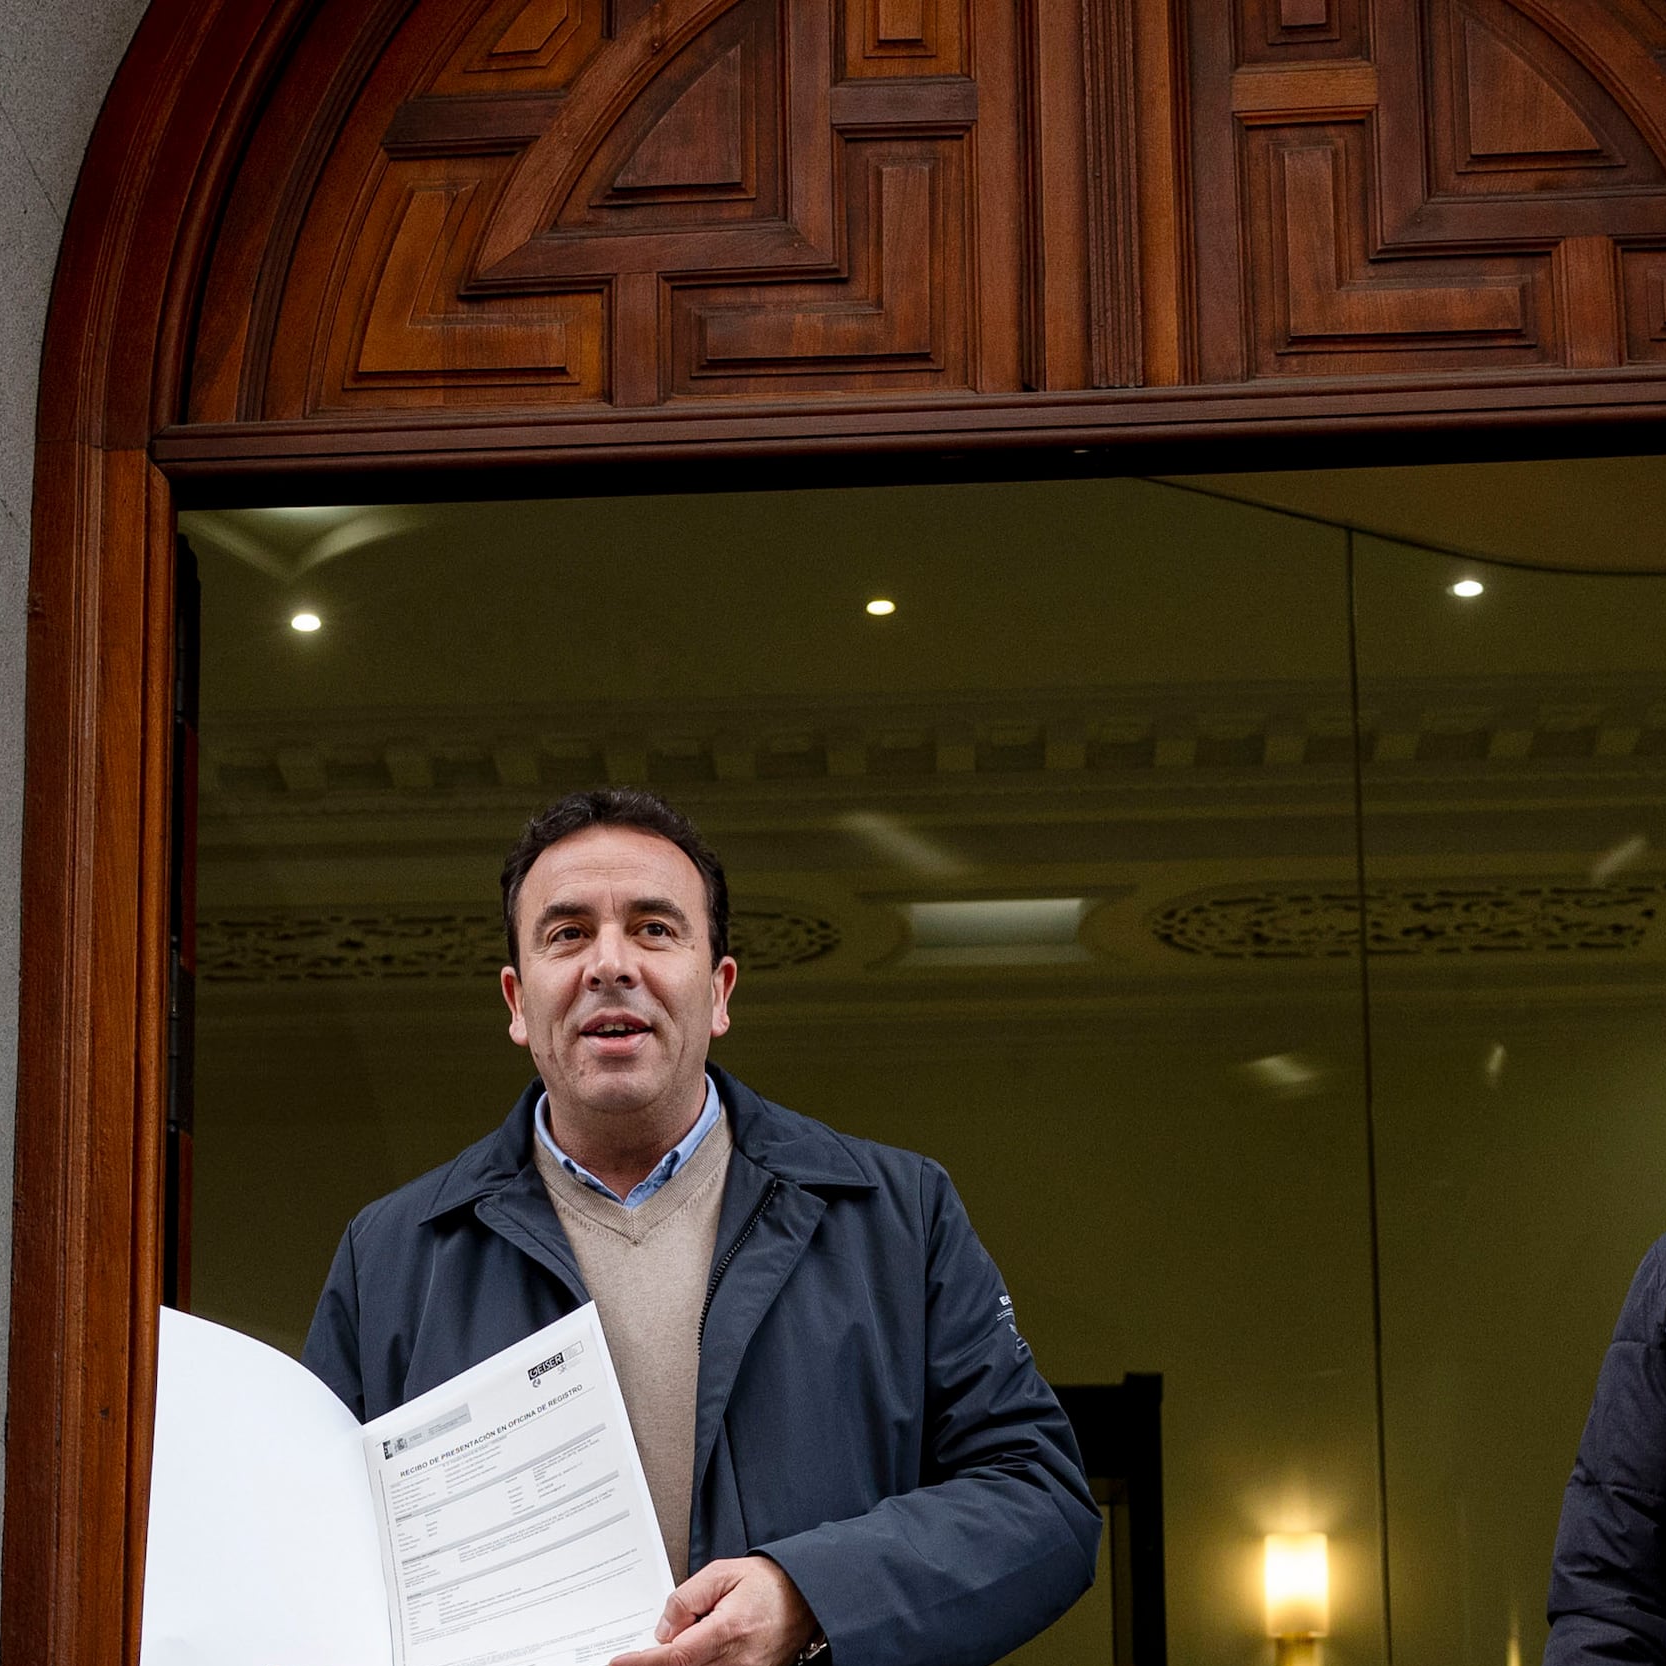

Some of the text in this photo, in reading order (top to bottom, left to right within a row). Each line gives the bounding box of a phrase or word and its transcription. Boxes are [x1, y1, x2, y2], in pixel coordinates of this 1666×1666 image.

[400, 1384, 583, 1478] RECIBO DE PRESENTACIÓN EN OFICINA DE REGISTRO
